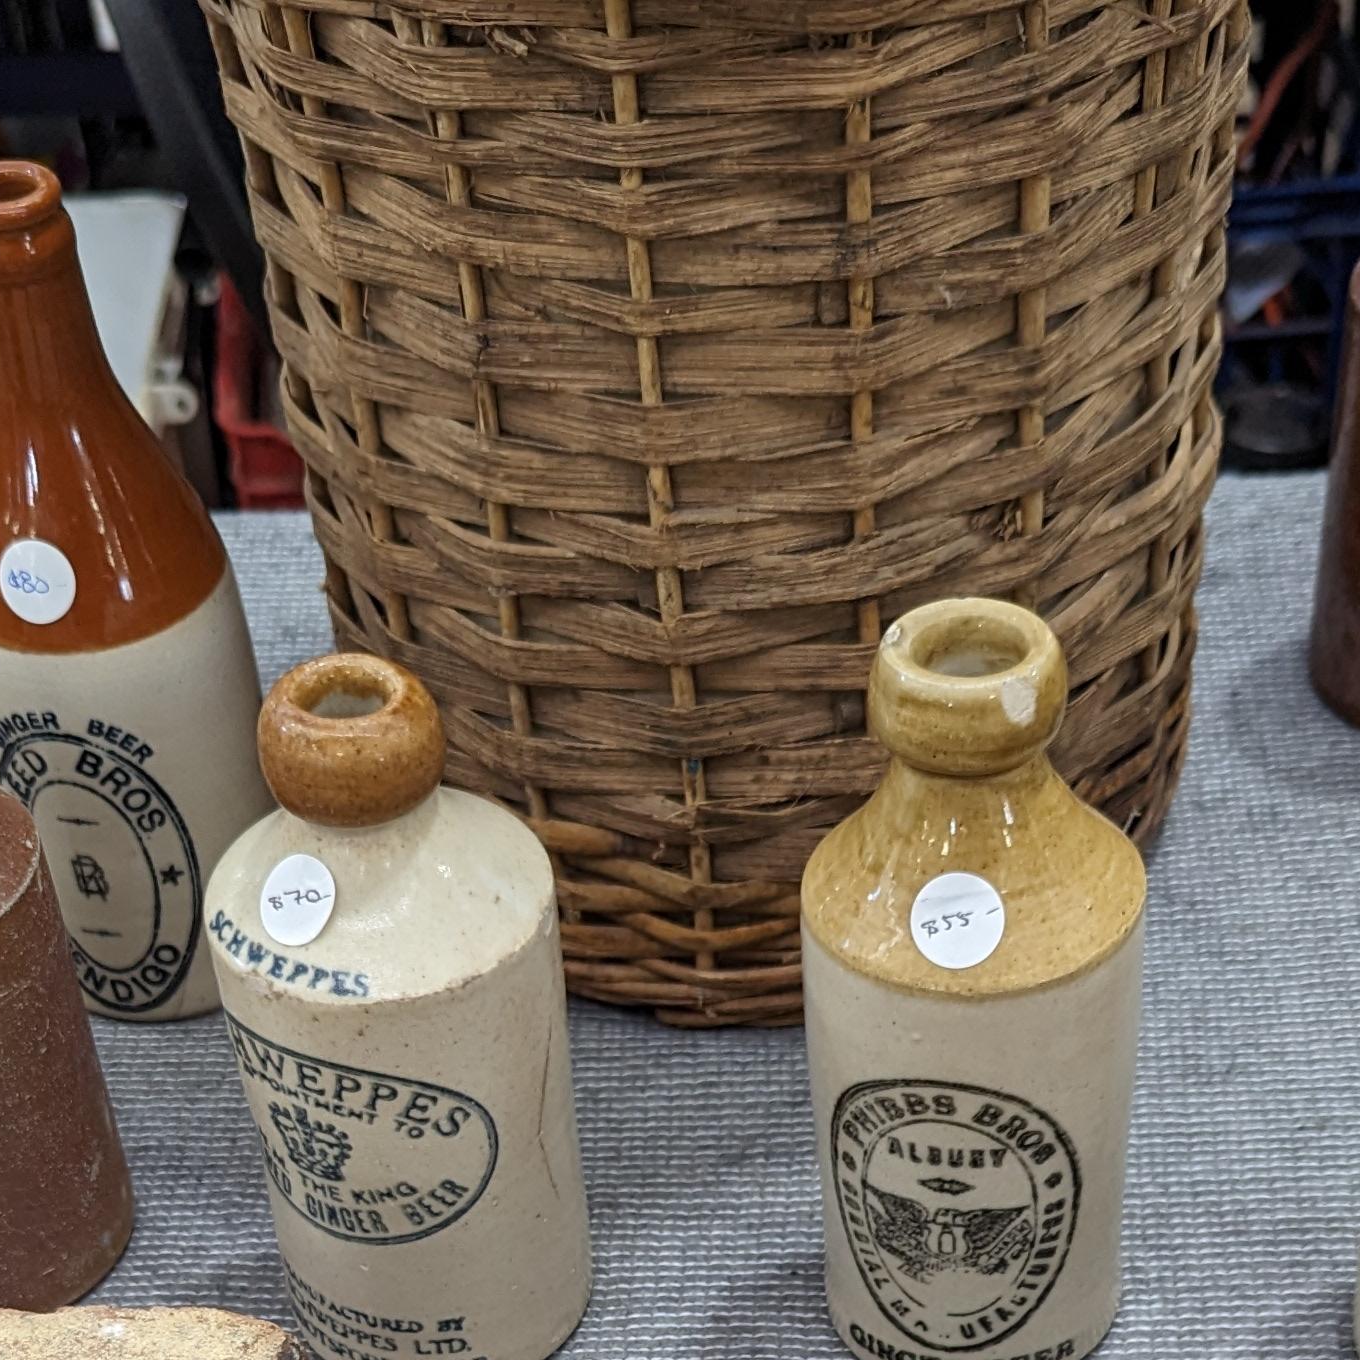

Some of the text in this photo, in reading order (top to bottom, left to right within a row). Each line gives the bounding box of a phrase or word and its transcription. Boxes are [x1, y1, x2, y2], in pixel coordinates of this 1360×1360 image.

[86, 718, 154, 764] BEER
[5, 749, 168, 834] EED BROS
[208, 910, 370, 998] SCHWEPPES
[394, 1118, 425, 1140] TO
[842, 1092, 958, 1148] PHIBBS
[887, 1136, 1009, 1169] ALBURY
[297, 1170, 344, 1203] THE
[350, 1181, 419, 1206] KING
[304, 1178, 470, 1234] GINGER BEER
[436, 1316, 467, 1333] BY
[414, 1338, 472, 1355] LTD.
